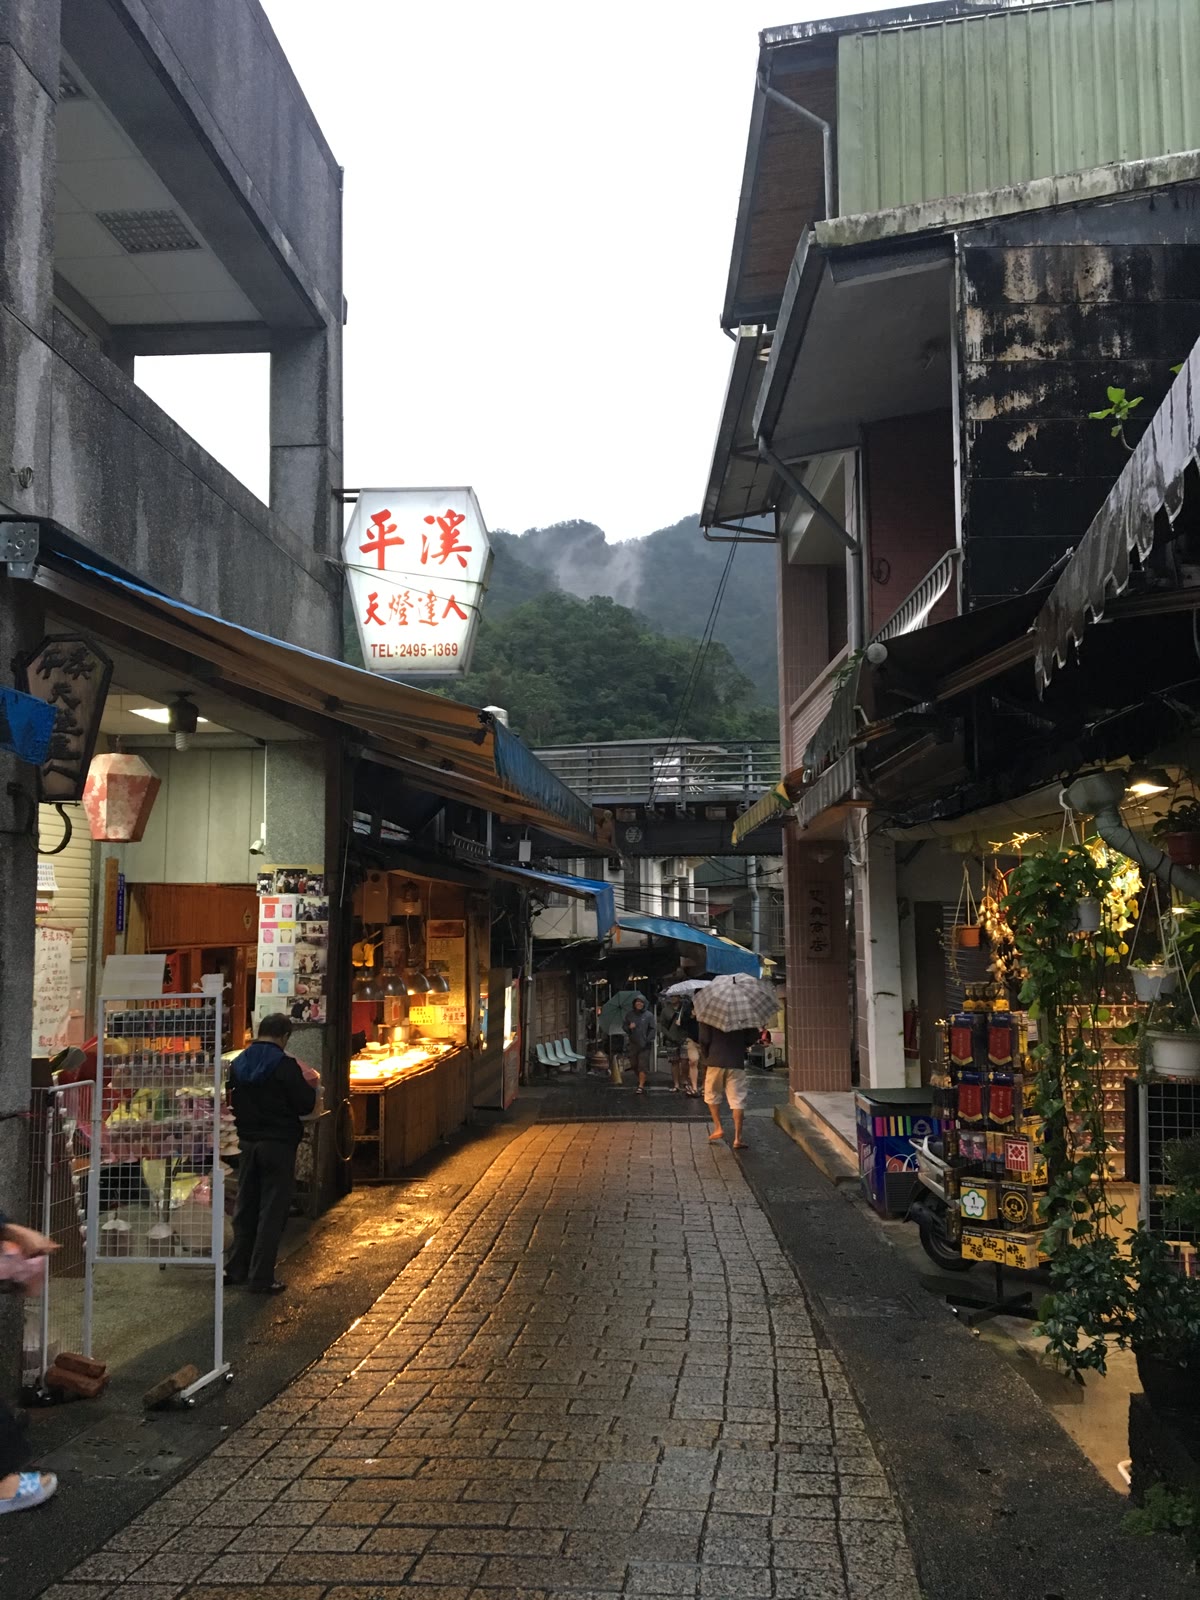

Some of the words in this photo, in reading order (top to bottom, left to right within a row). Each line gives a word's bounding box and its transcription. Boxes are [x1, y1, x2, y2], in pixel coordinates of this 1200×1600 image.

[359, 508, 472, 570] 平溪
[363, 589, 468, 626] 天燈達人
[370, 642, 459, 658] TEL:2495-1369
